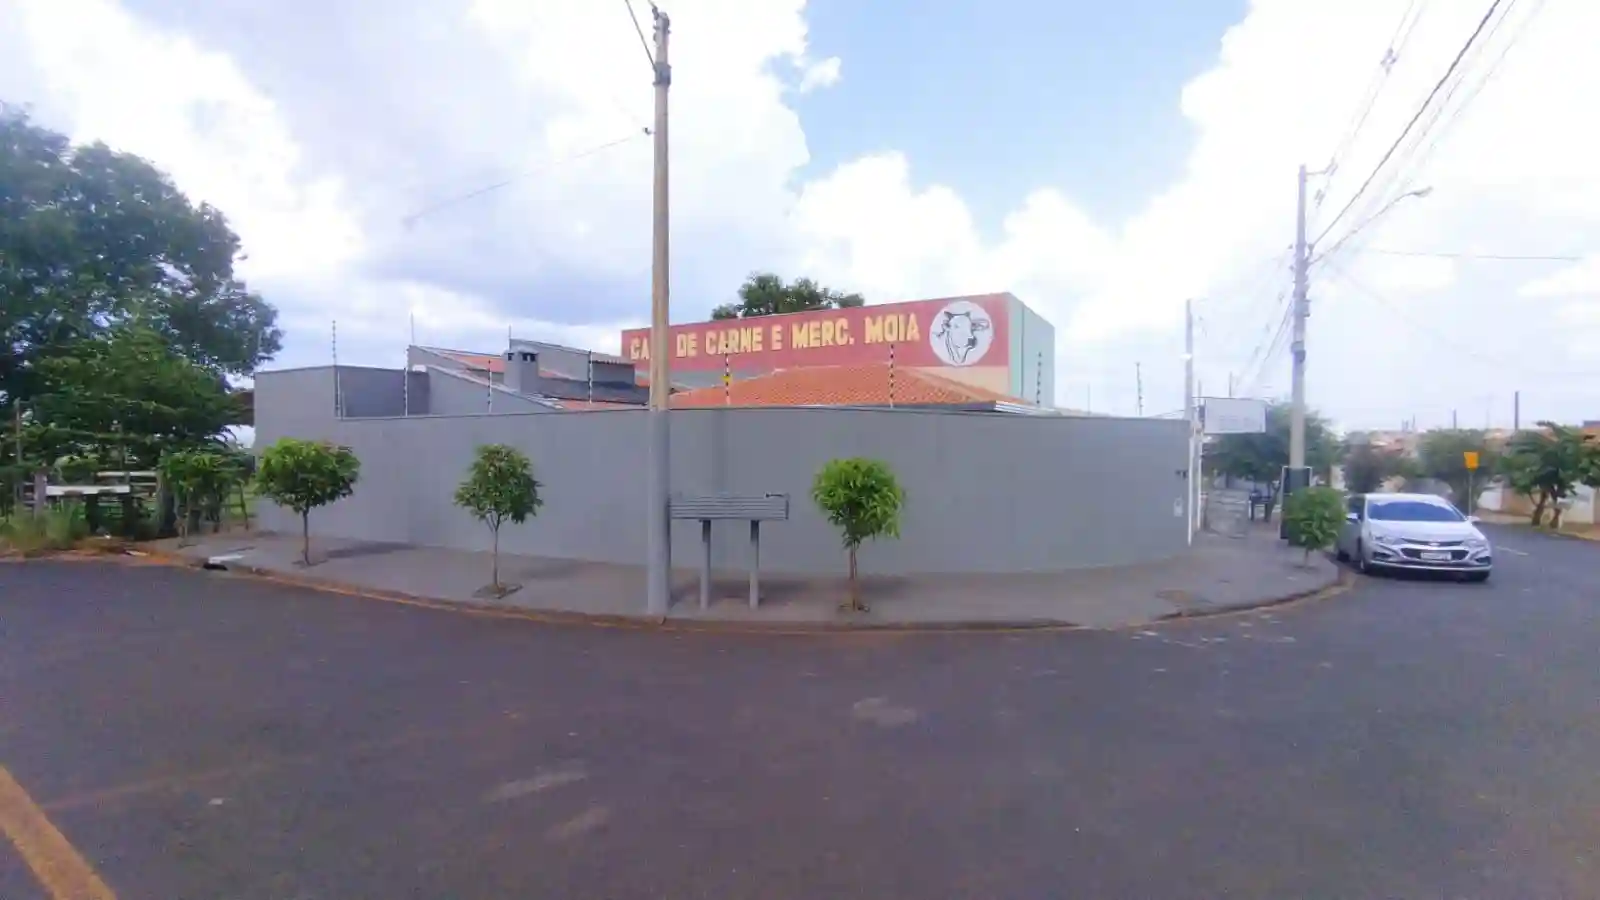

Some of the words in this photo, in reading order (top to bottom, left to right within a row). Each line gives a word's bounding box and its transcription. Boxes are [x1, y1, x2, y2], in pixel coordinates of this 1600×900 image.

[676, 333, 697, 357] DE
[705, 327, 763, 355] CARNE
[771, 324, 783, 350] E
[792, 318, 855, 349] MERC.
[864, 313, 921, 344] MOIA
